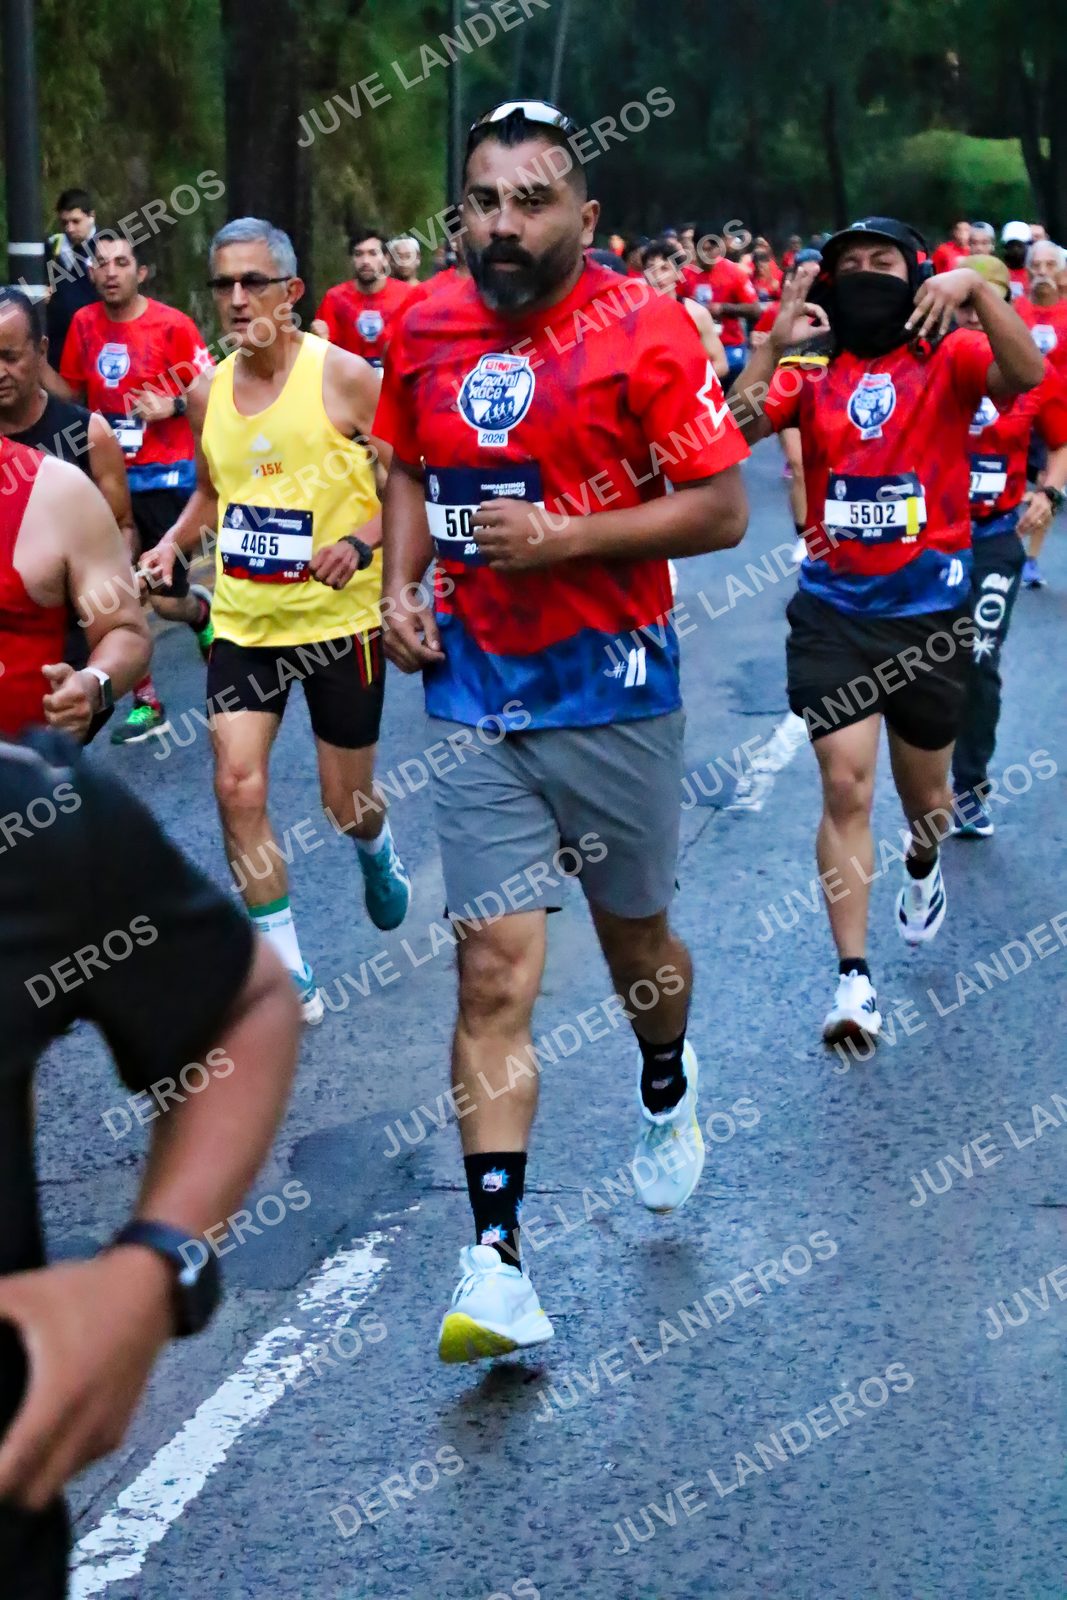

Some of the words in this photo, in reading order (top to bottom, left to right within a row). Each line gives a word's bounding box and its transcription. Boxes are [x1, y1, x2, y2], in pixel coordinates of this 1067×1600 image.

[481, 433, 506, 444] 2026
[445, 508, 486, 537] 50
[850, 504, 896, 525] 5502
[241, 533, 279, 556] 4465
